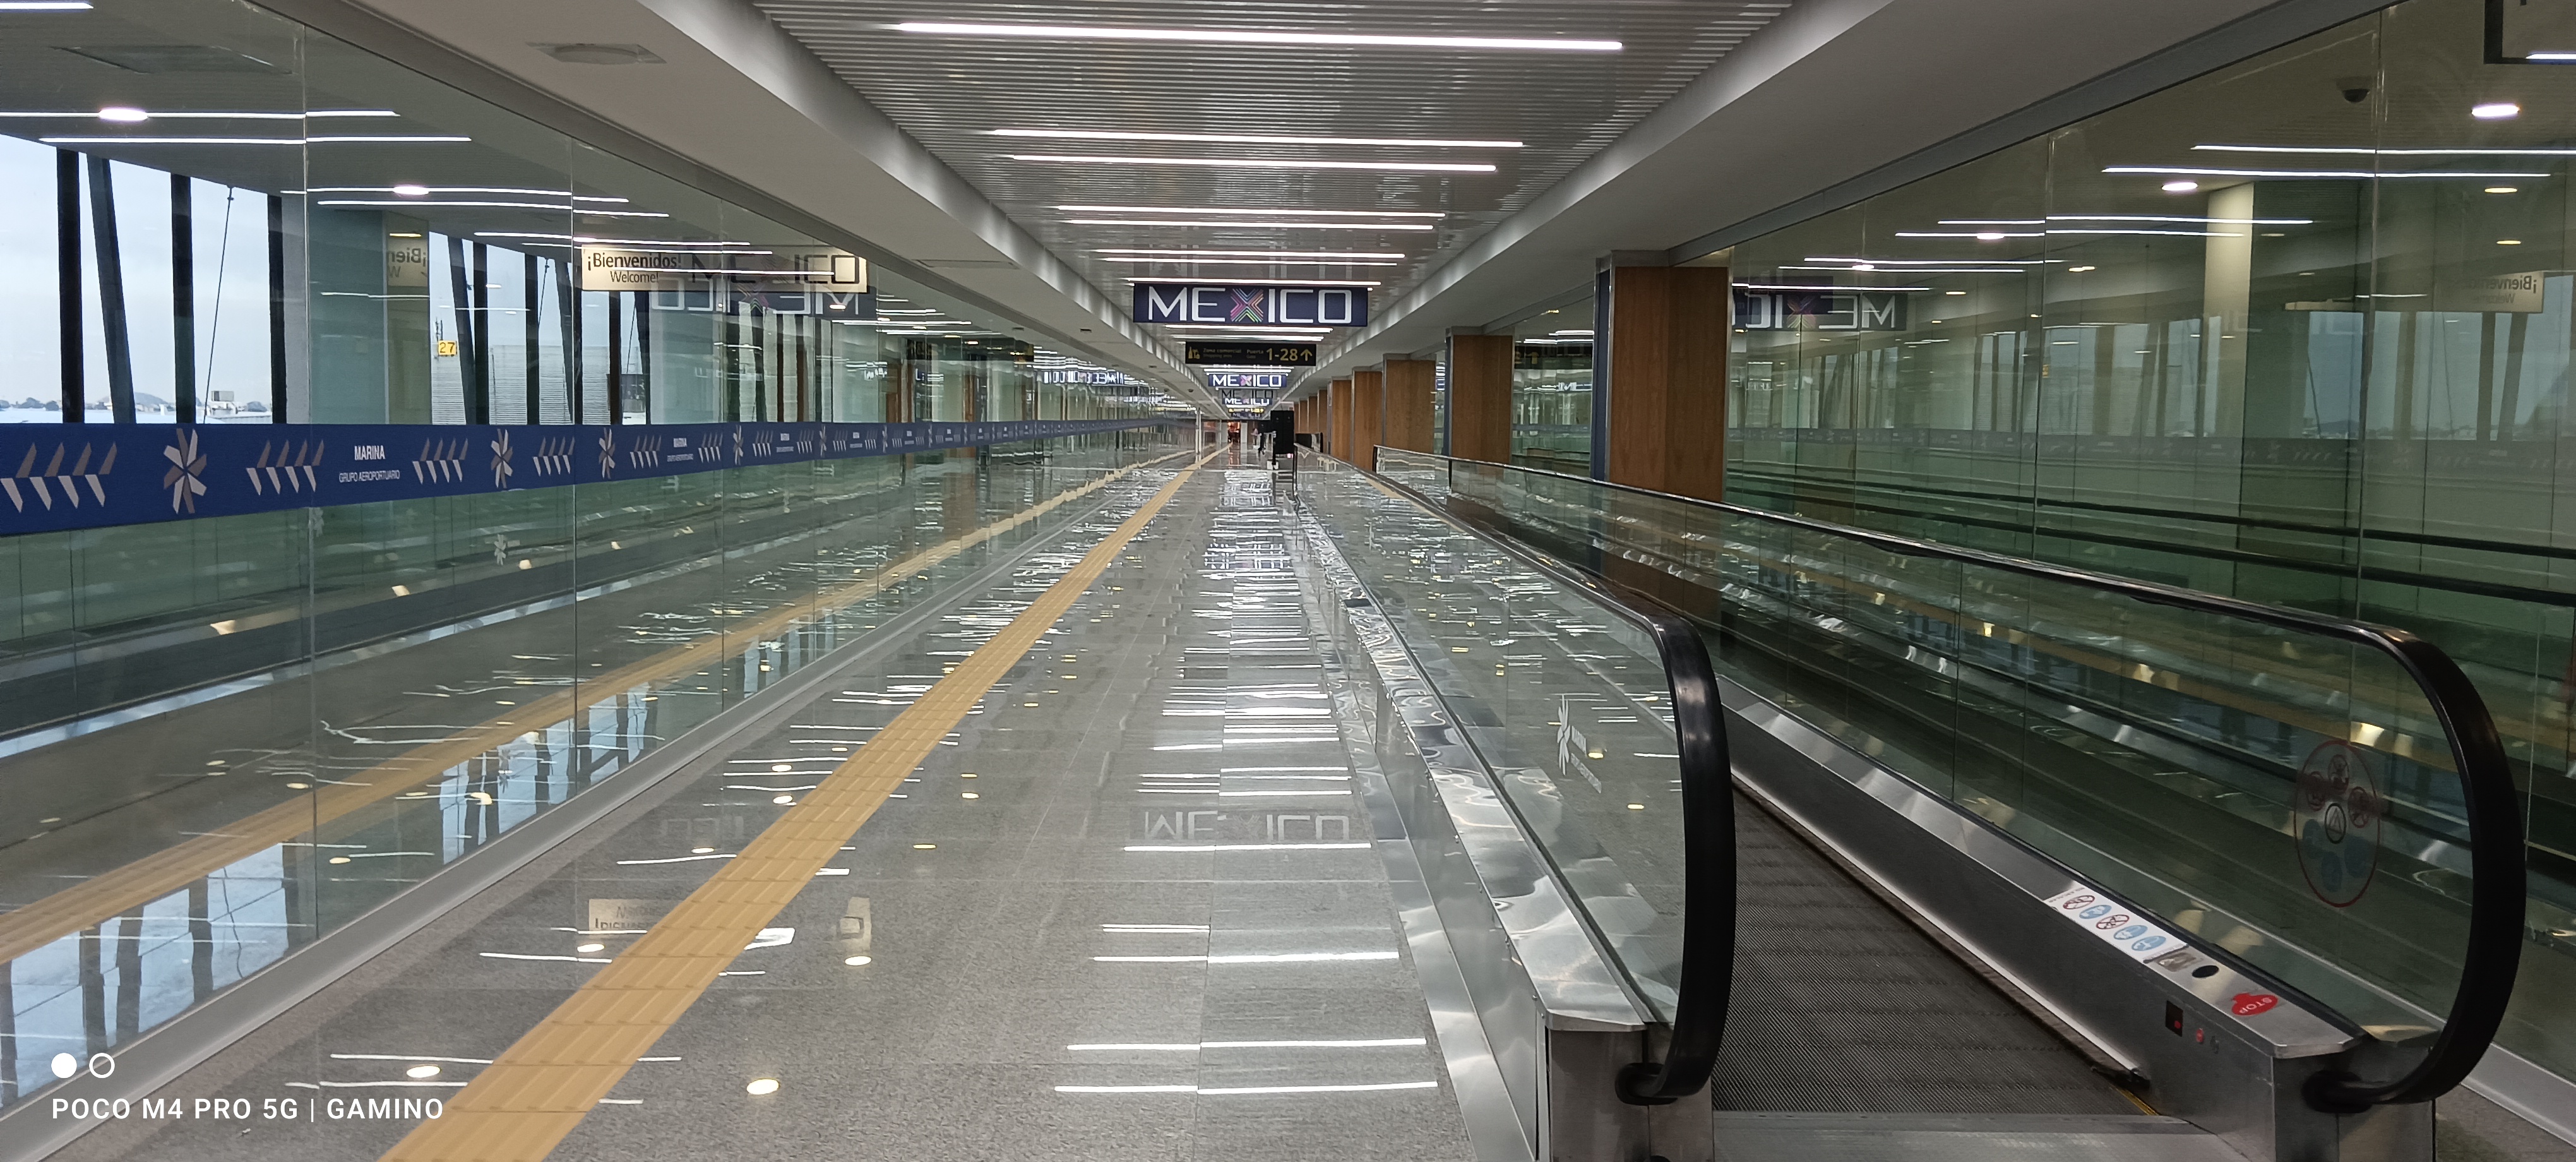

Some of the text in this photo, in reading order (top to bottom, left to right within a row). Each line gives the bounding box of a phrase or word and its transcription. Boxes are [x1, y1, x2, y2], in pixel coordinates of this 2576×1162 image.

[588, 253, 682, 270] ¡Bienvenidos!
[610, 270, 659, 283] Welcome!
[1148, 286, 1352, 323] MEXICO
[439, 342, 455, 353] 27
[1266, 347, 1298, 361] 1-28
[1213, 374, 1282, 386] MEXICO
[354, 445, 386, 460] MARINA
[339, 472, 358, 482] GRUPO
